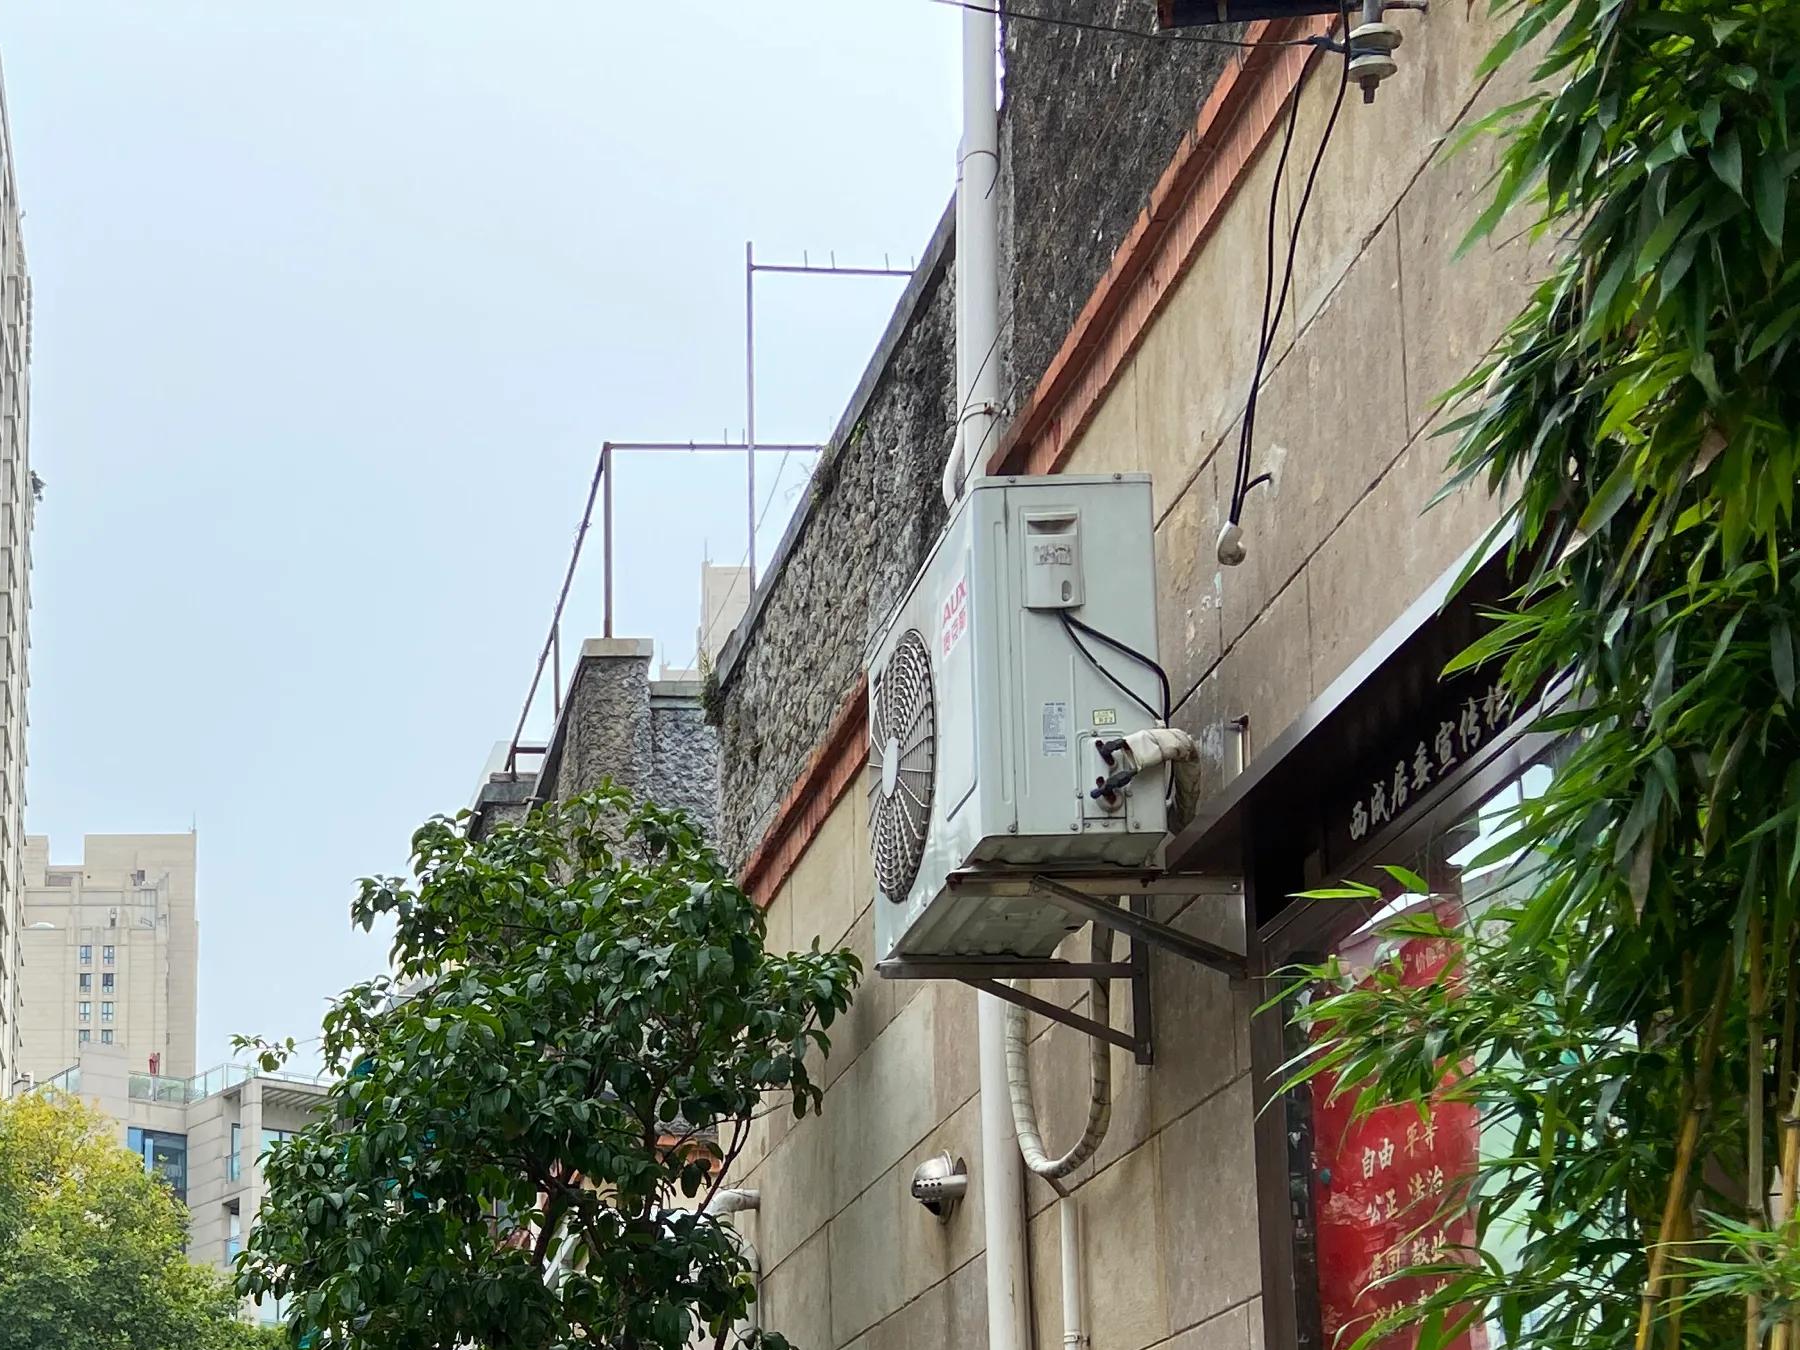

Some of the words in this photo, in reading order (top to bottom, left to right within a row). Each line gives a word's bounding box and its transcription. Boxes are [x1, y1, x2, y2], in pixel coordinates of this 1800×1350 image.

[943, 576, 967, 630] AUX
[1362, 1137, 1395, 1179] 自由
[1366, 1188, 1398, 1226] 公正
[1408, 1165, 1443, 1201] 法治
